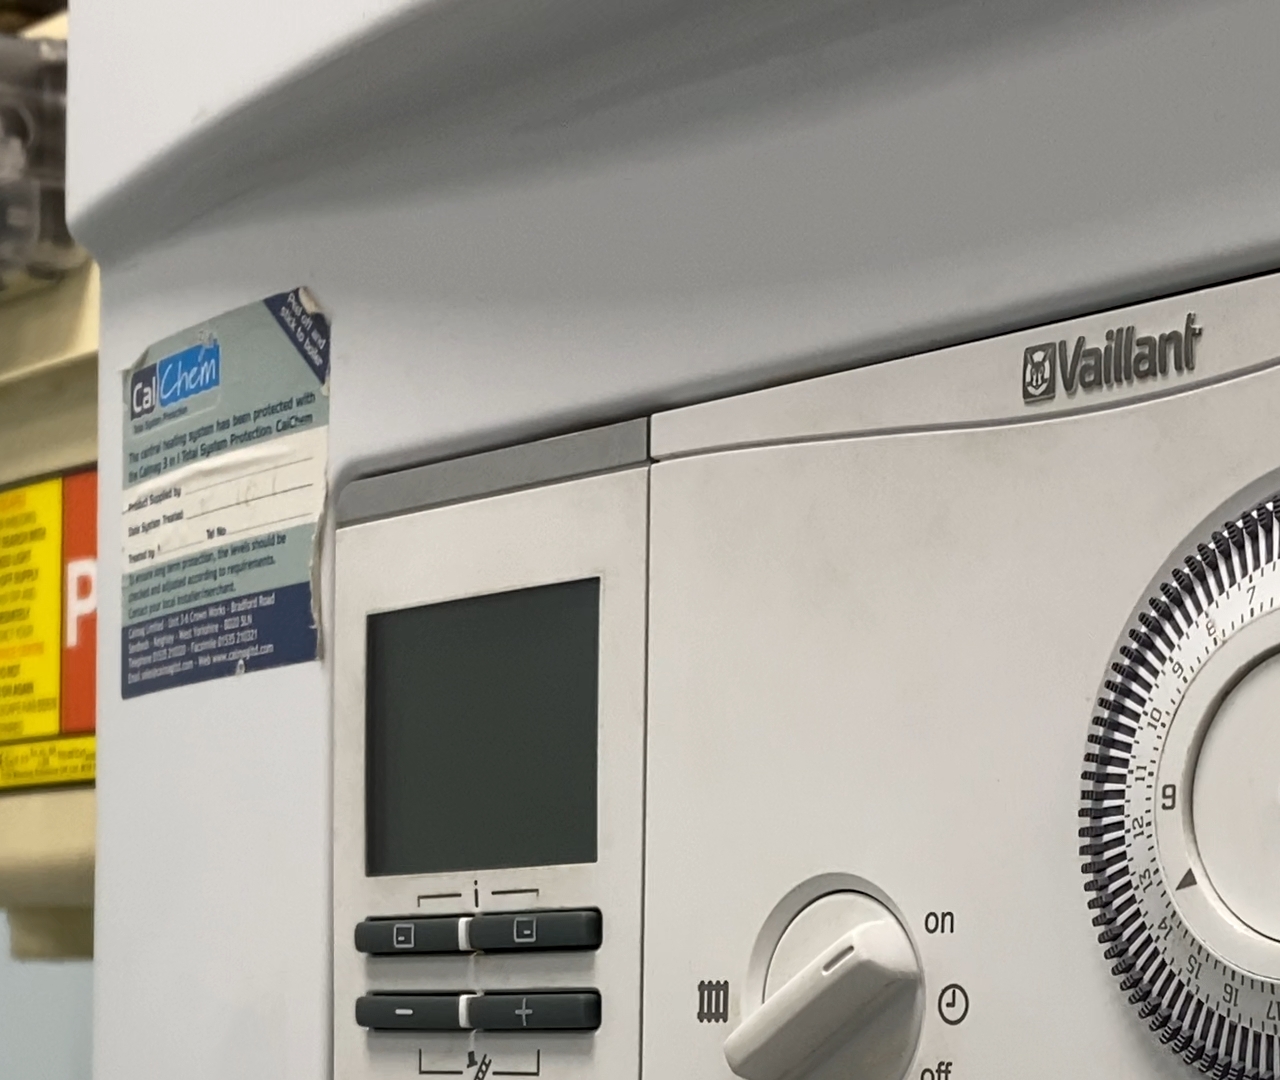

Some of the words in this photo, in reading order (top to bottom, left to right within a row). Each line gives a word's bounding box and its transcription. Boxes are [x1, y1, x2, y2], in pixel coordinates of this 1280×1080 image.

[1058, 312, 1203, 394] Vaillant
[253, 396, 293, 424] protected
[230, 424, 272, 445] Protection
[1246, 585, 1256, 606] 7
[1172, 661, 1184, 679] 9
[1147, 707, 1162, 731] 10
[1134, 765, 1147, 782] 11
[1161, 783, 1177, 811] 9
[1132, 815, 1145, 840] 12
[1138, 867, 1154, 894] 13
[923, 910, 955, 934] on
